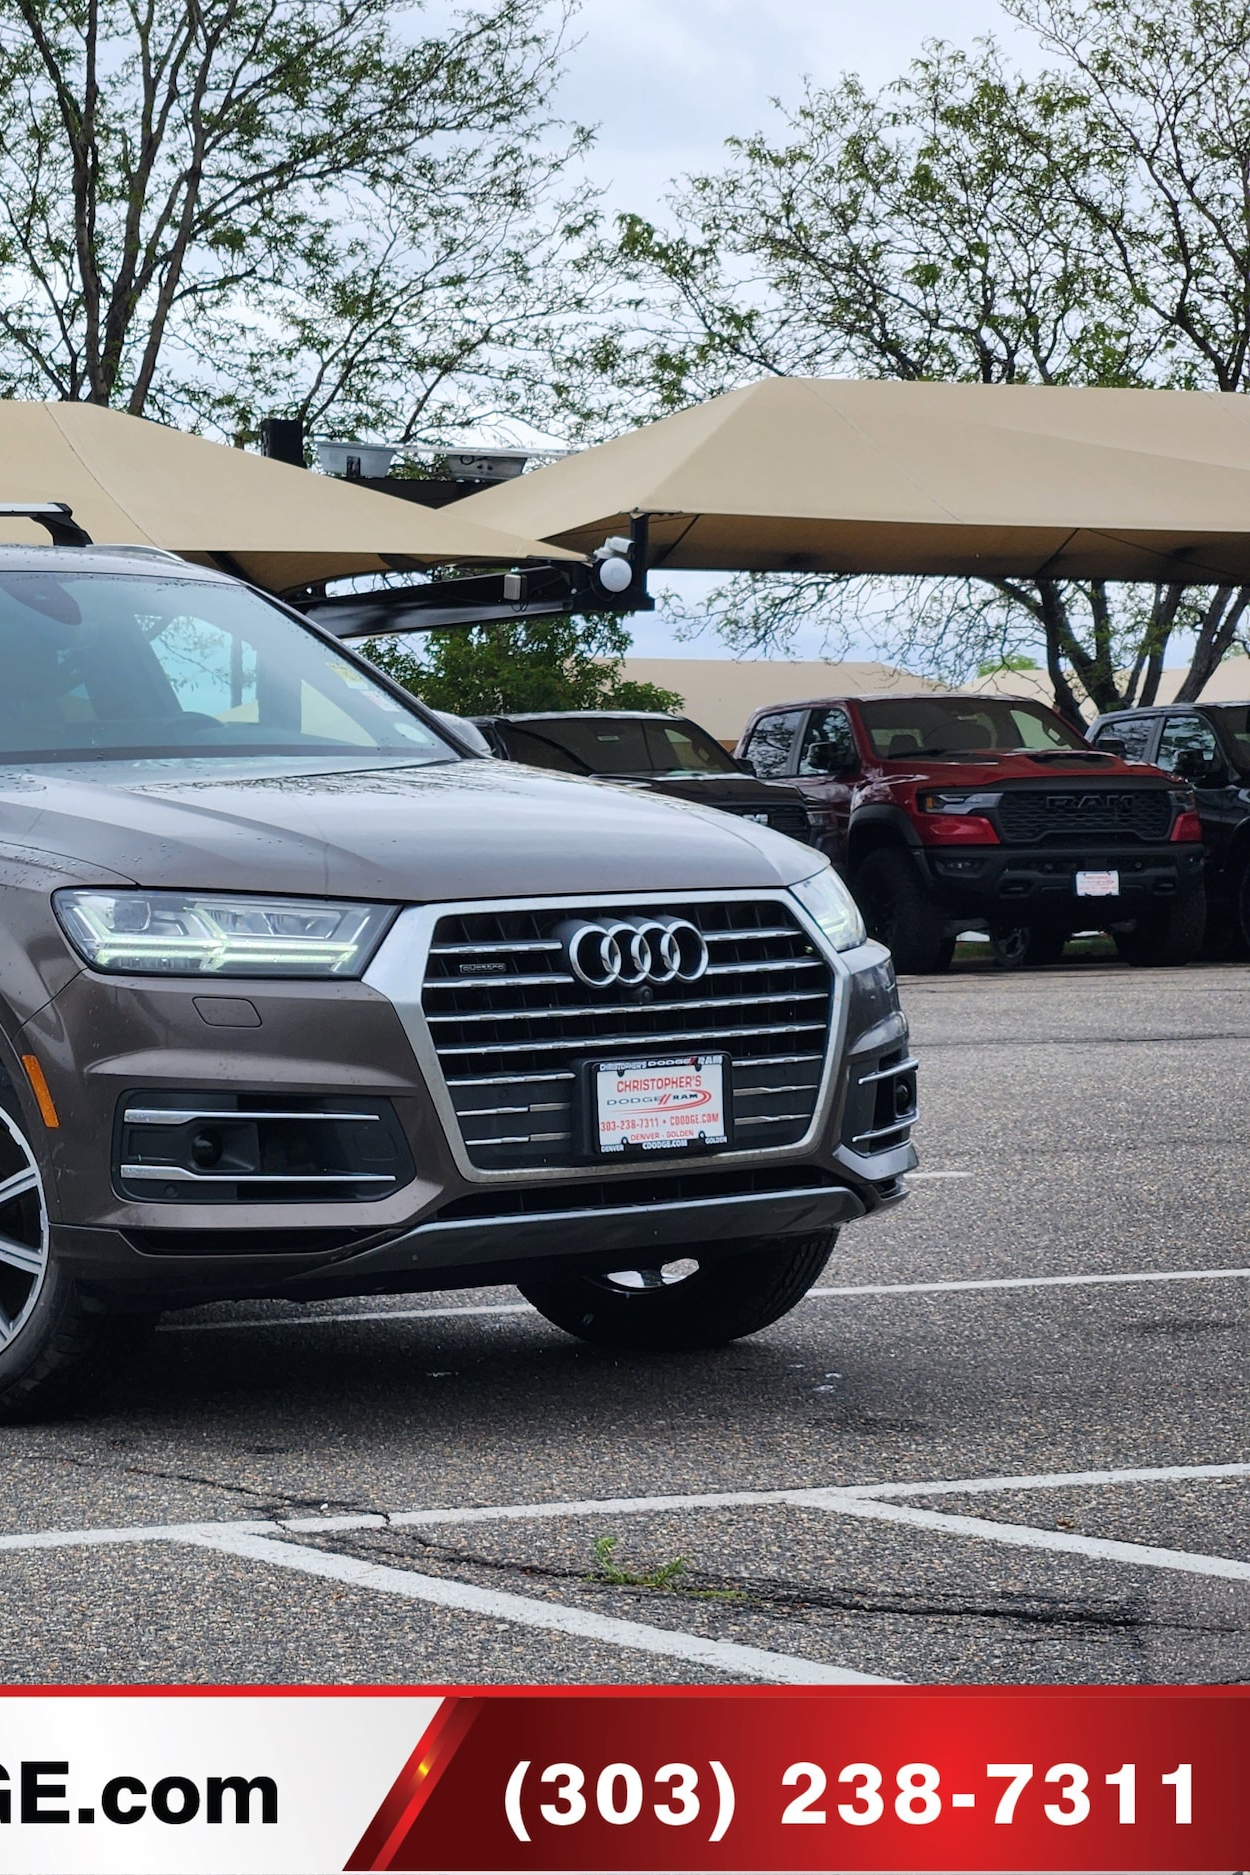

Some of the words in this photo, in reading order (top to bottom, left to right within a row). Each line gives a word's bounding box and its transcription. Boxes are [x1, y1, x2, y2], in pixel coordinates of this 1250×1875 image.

[1046, 795, 1134, 810] RAM
[697, 1055, 723, 1065] RAM
[616, 1075, 702, 1093] CHRISTOPHER'S
[606, 1096, 662, 1106] DODGE
[672, 1093, 698, 1101] RAM
[600, 1117, 659, 1132] 303-238-7311
[669, 1112, 719, 1126] CDODGE.COM
[630, 1132, 660, 1141] DENVER
[666, 1129, 694, 1138] GOLDEN
[705, 1136, 728, 1144] GOLDEN
[600, 1144, 624, 1153] DENVER
[642, 1139, 688, 1150] CDODGE.COM
